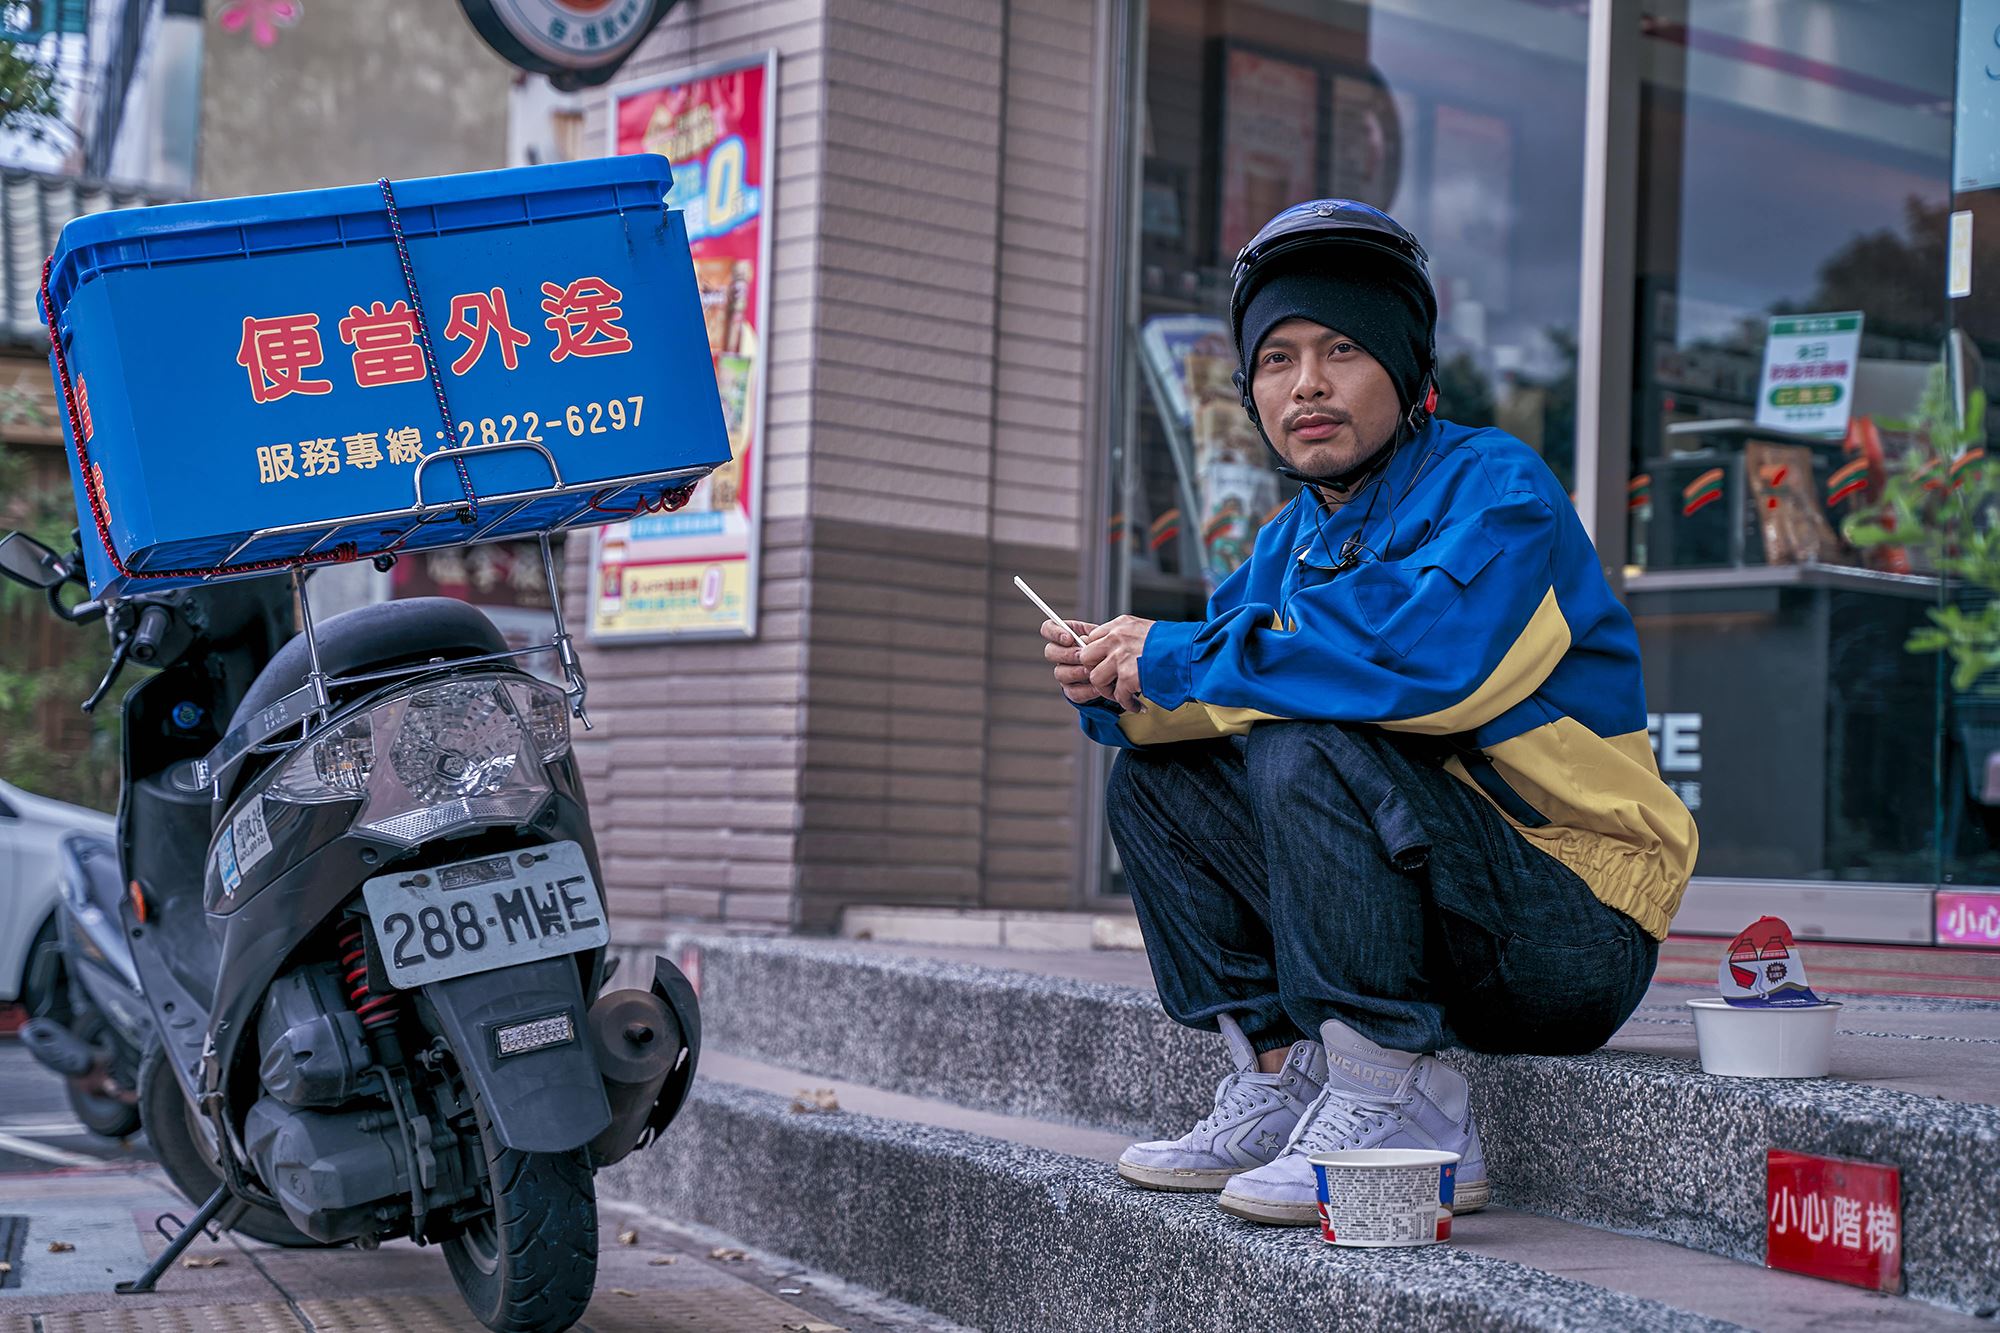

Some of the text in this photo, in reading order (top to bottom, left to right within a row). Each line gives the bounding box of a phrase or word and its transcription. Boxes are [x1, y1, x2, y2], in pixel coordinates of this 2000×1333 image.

[236, 276, 633, 403] 便當外送
[383, 874, 601, 969] 288-MWE
[1770, 1186, 1897, 1255] 小心階梯
